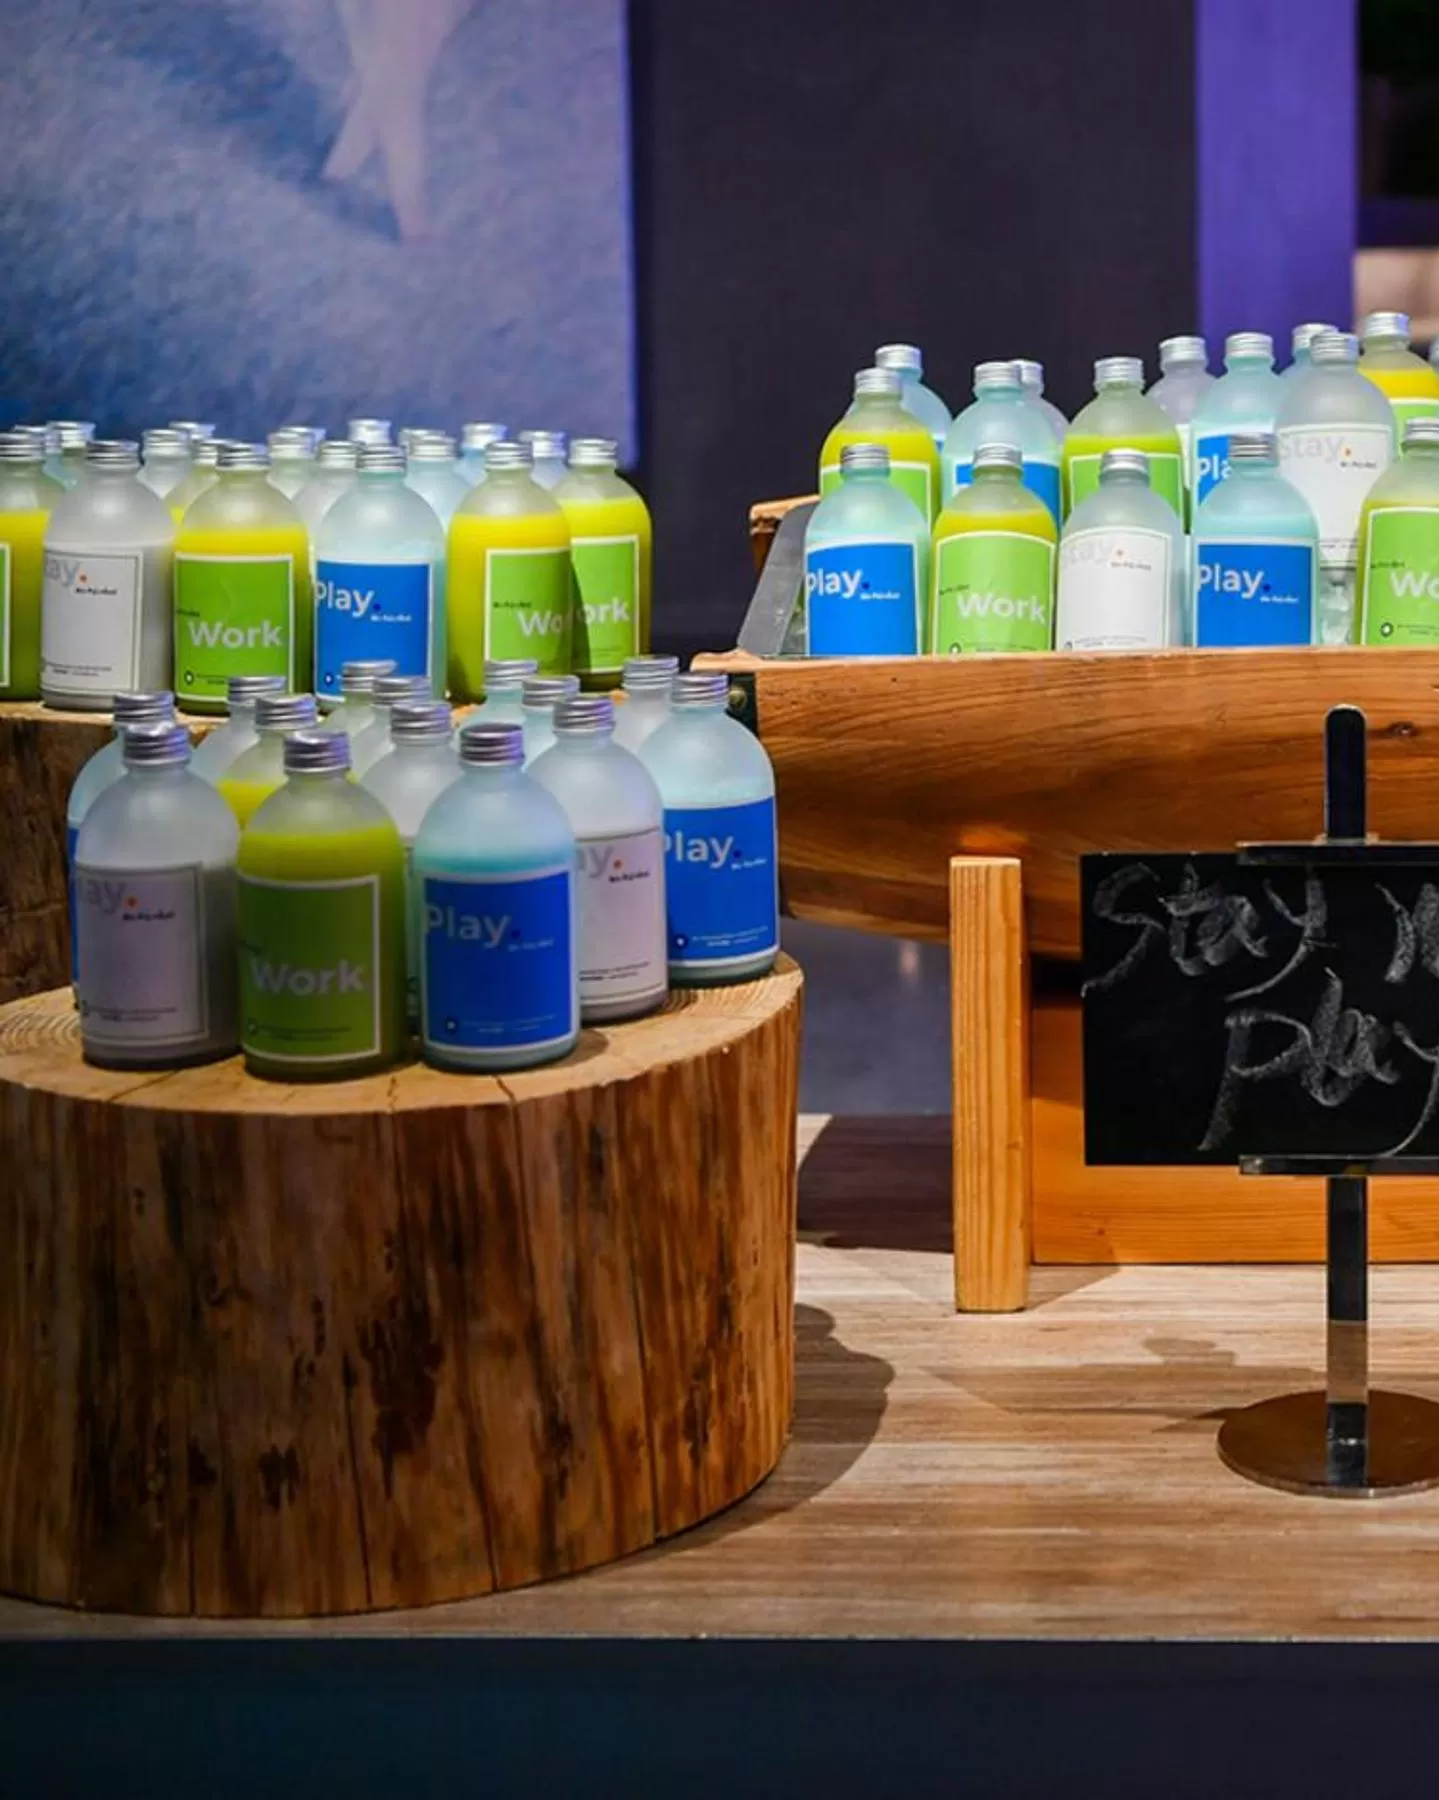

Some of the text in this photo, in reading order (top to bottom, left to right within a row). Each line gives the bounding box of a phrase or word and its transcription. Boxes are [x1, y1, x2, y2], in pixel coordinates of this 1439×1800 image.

[583, 597, 629, 624] ork
[956, 590, 1046, 625] Work
[187, 619, 283, 650] Work
[1082, 862, 1337, 1001] Stay
[252, 958, 366, 997] Work
